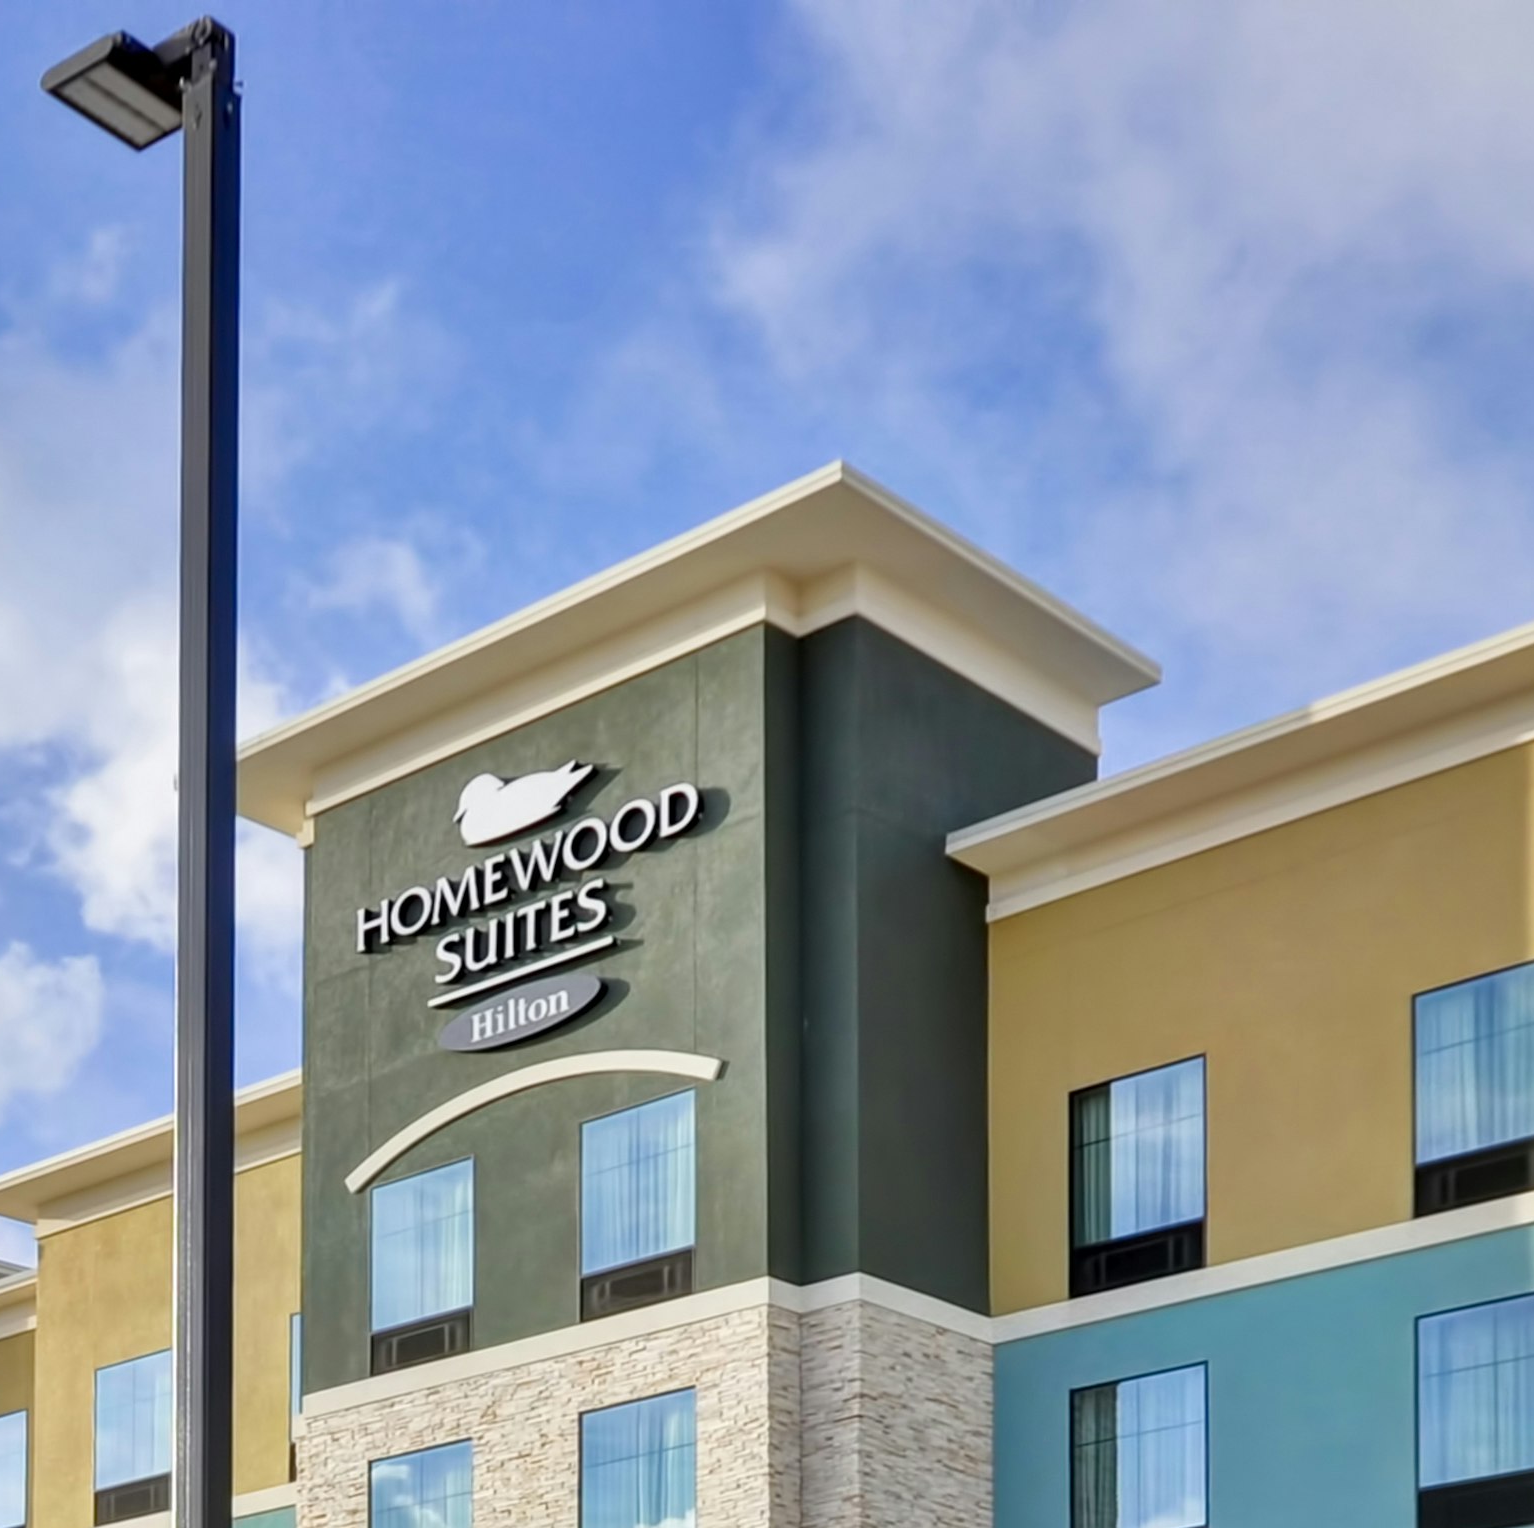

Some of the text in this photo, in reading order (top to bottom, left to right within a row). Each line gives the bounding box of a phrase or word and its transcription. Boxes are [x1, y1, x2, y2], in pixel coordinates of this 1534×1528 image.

[356, 782, 700, 953] HOMEWOOD
[435, 878, 607, 985] SUITES
[469, 988, 570, 1043] Hilton
